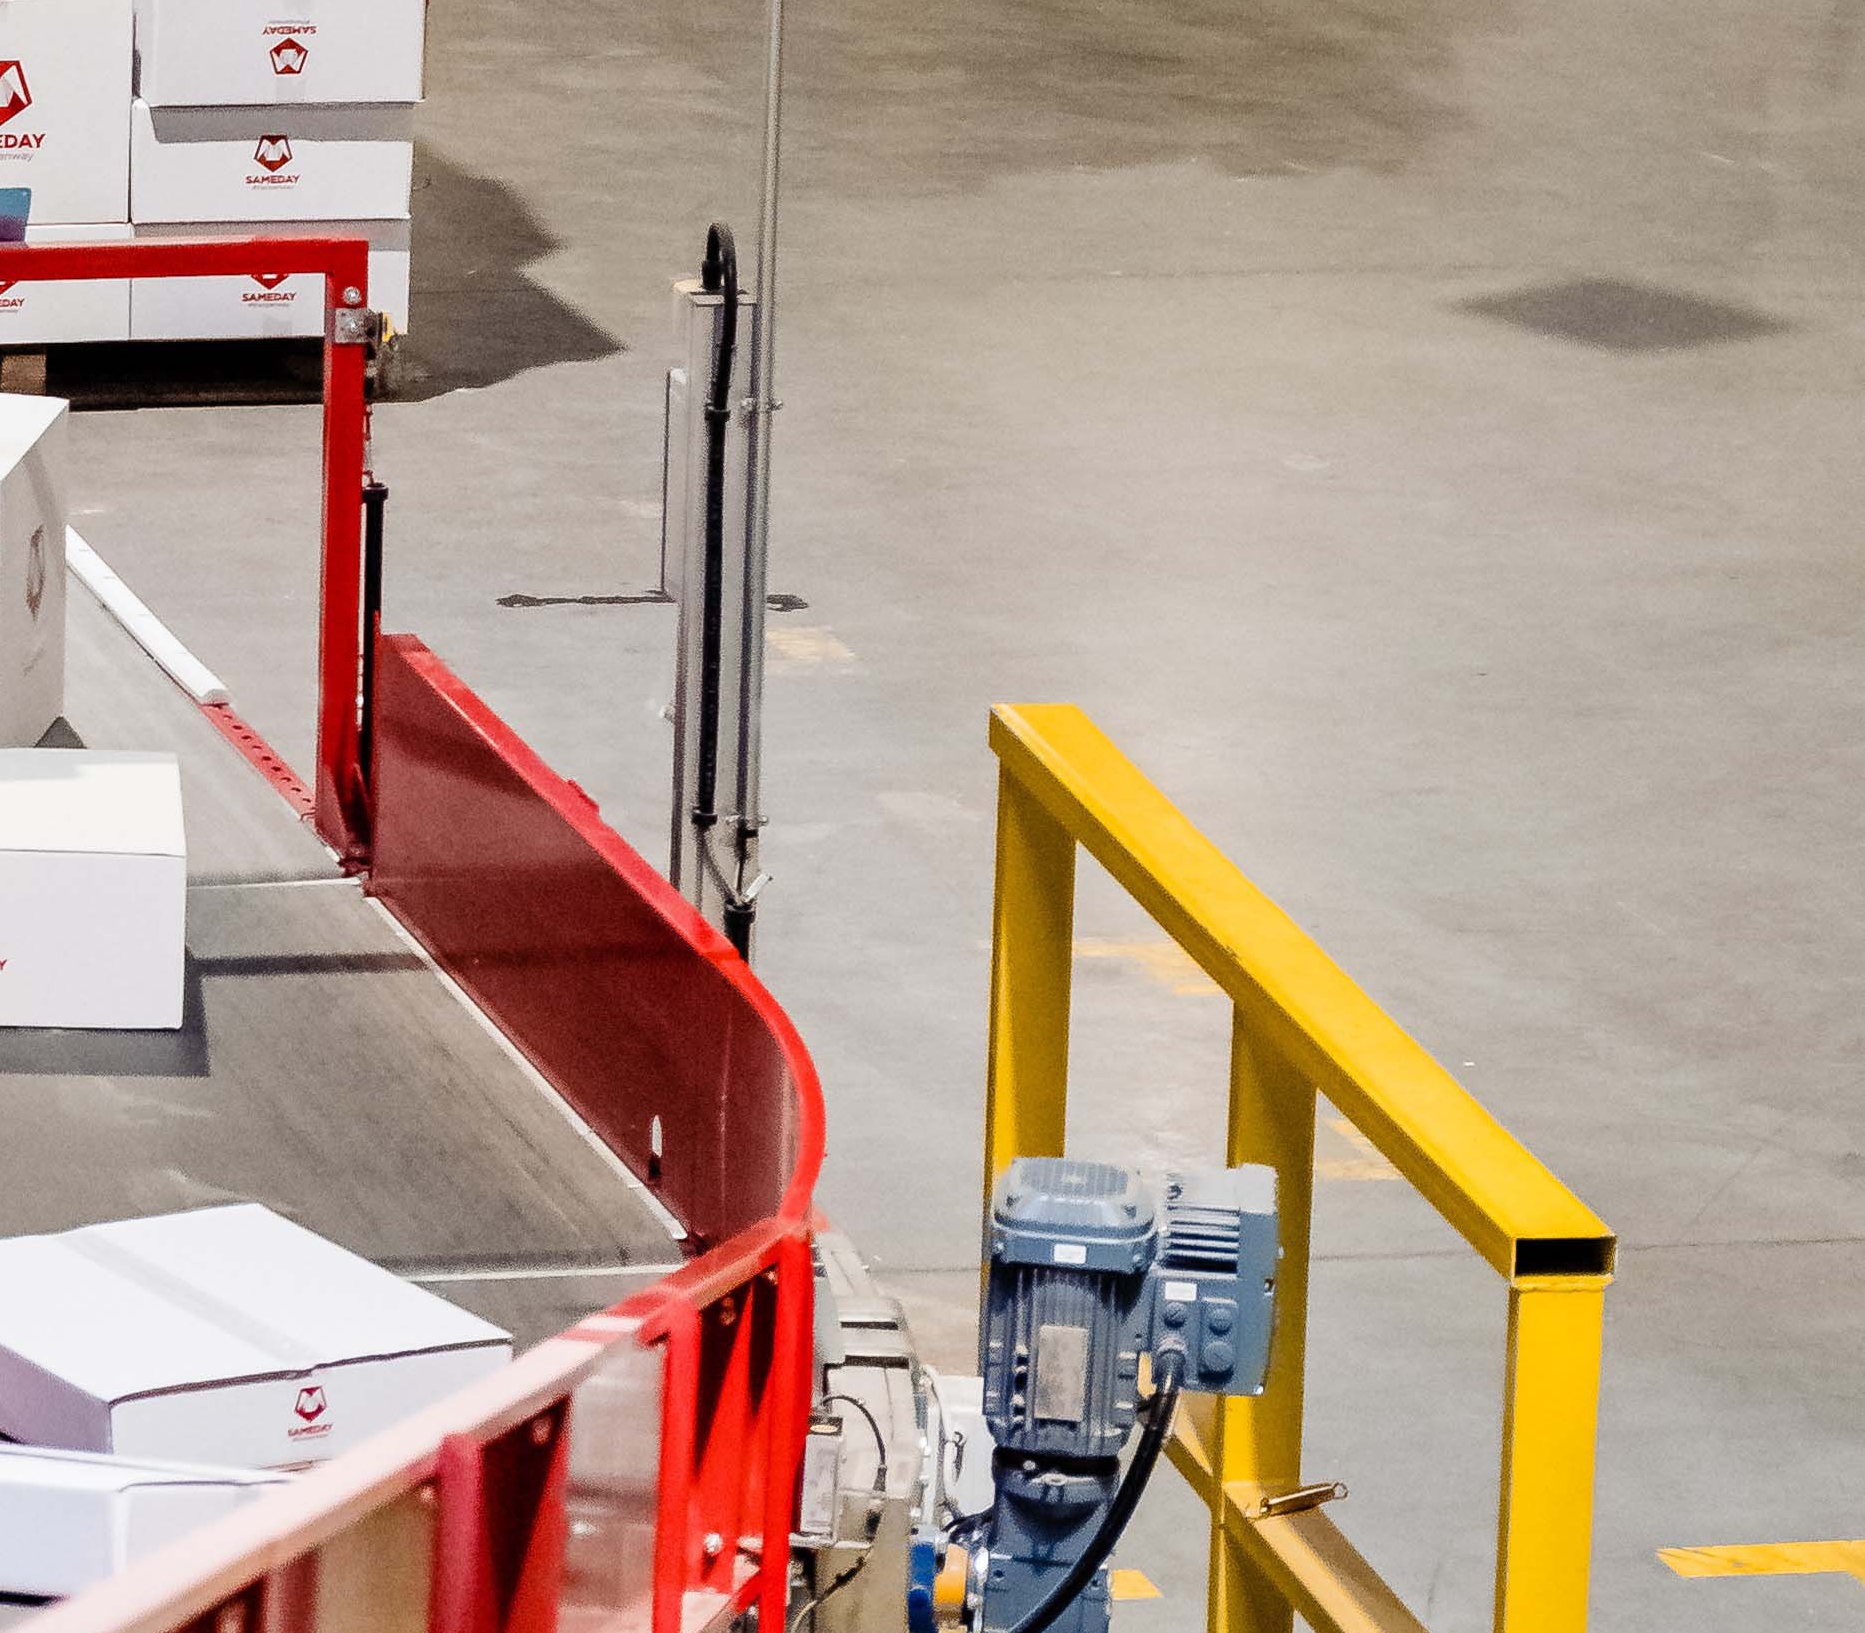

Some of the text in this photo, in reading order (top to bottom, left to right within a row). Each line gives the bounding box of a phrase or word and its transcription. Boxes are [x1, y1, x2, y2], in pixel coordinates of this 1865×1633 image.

[262, 26, 318, 36] SAMEDAY
[245, 174, 300, 185] SAMEDAY
[241, 292, 297, 303] SAMEDAY
